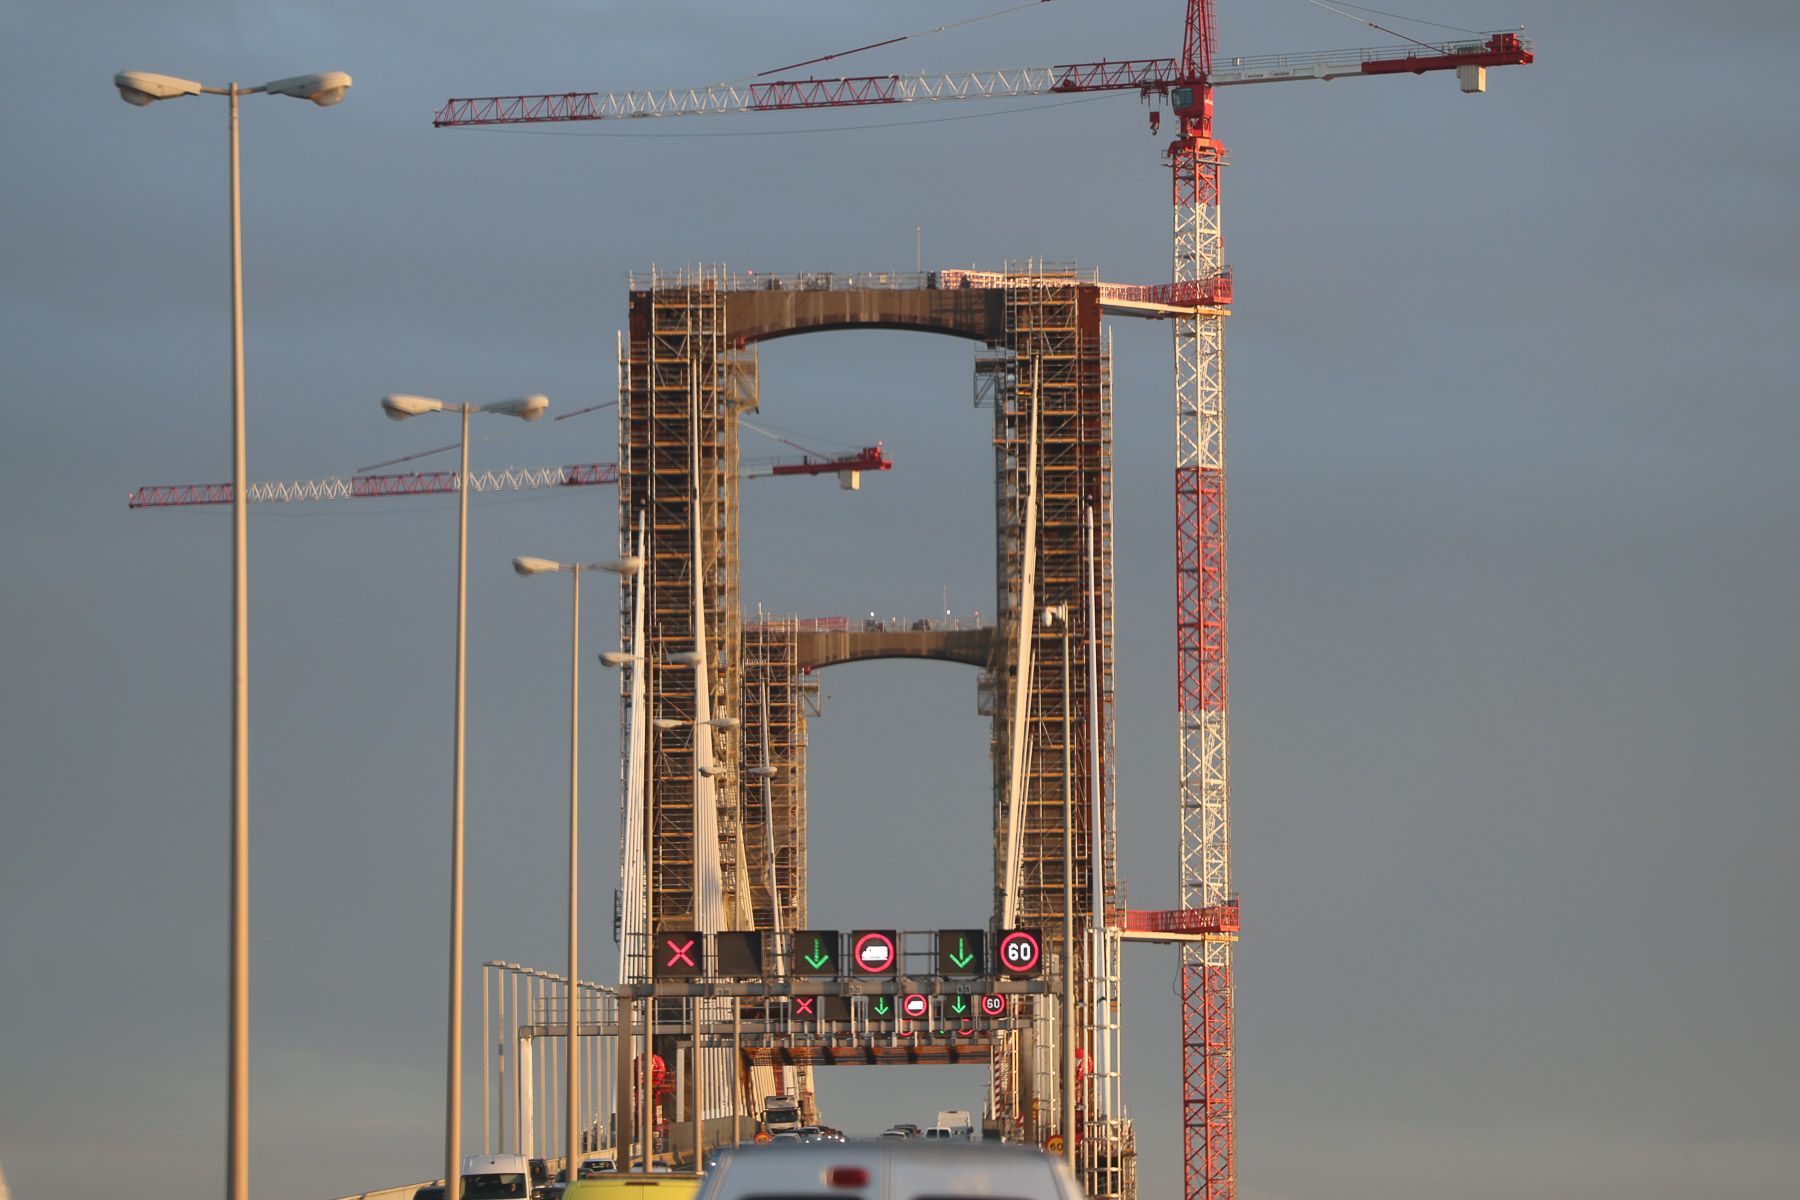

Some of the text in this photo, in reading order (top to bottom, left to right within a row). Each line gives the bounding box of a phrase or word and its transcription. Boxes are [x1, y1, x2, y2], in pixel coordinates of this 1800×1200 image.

[1008, 942, 1031, 961] 60
[986, 998, 1000, 1009] 60
[1049, 1142, 1064, 1152] 60
